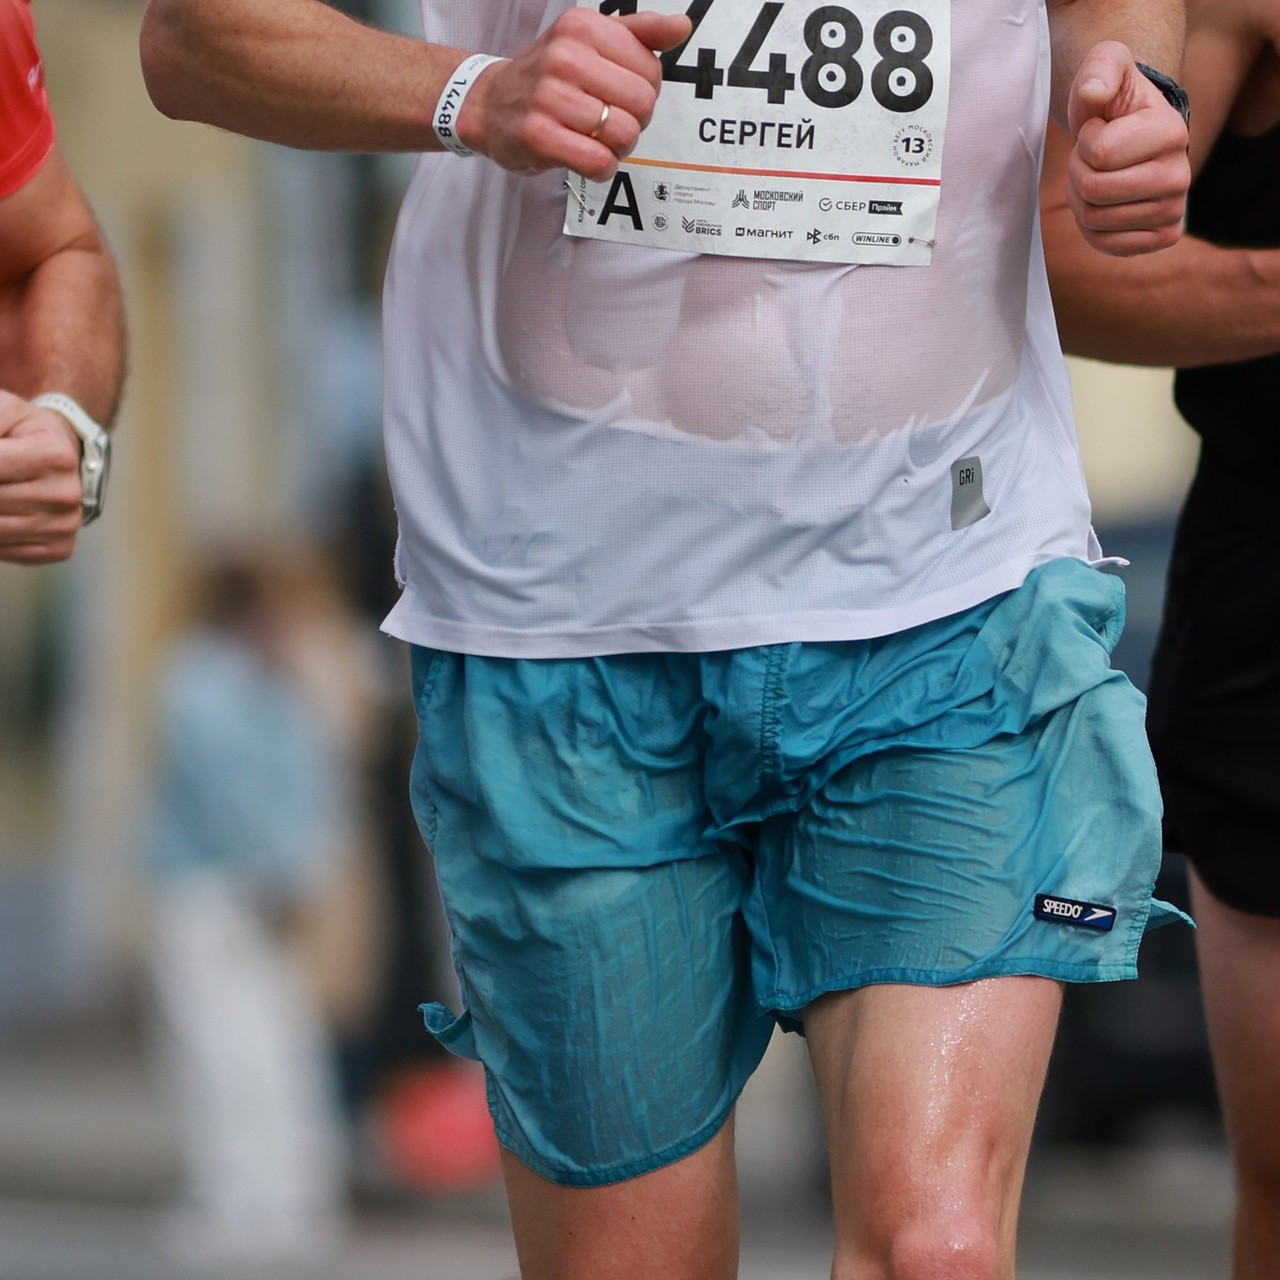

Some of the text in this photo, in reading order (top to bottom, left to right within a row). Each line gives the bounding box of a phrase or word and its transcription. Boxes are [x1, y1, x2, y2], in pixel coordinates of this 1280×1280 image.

[438, 79, 467, 138] 14488
[699, 117, 816, 150] СЕРГЕЙ
[901, 137, 925, 154] 13
[596, 171, 644, 231] A
[753, 190, 804, 202] МОСКОВСКИЙ
[752, 200, 776, 211] СПОРТ
[836, 201, 866, 211] СБЕР
[695, 226, 722, 236] BRICS
[855, 234, 891, 244] WINLINE
[1042, 899, 1081, 919] SPEEDO
